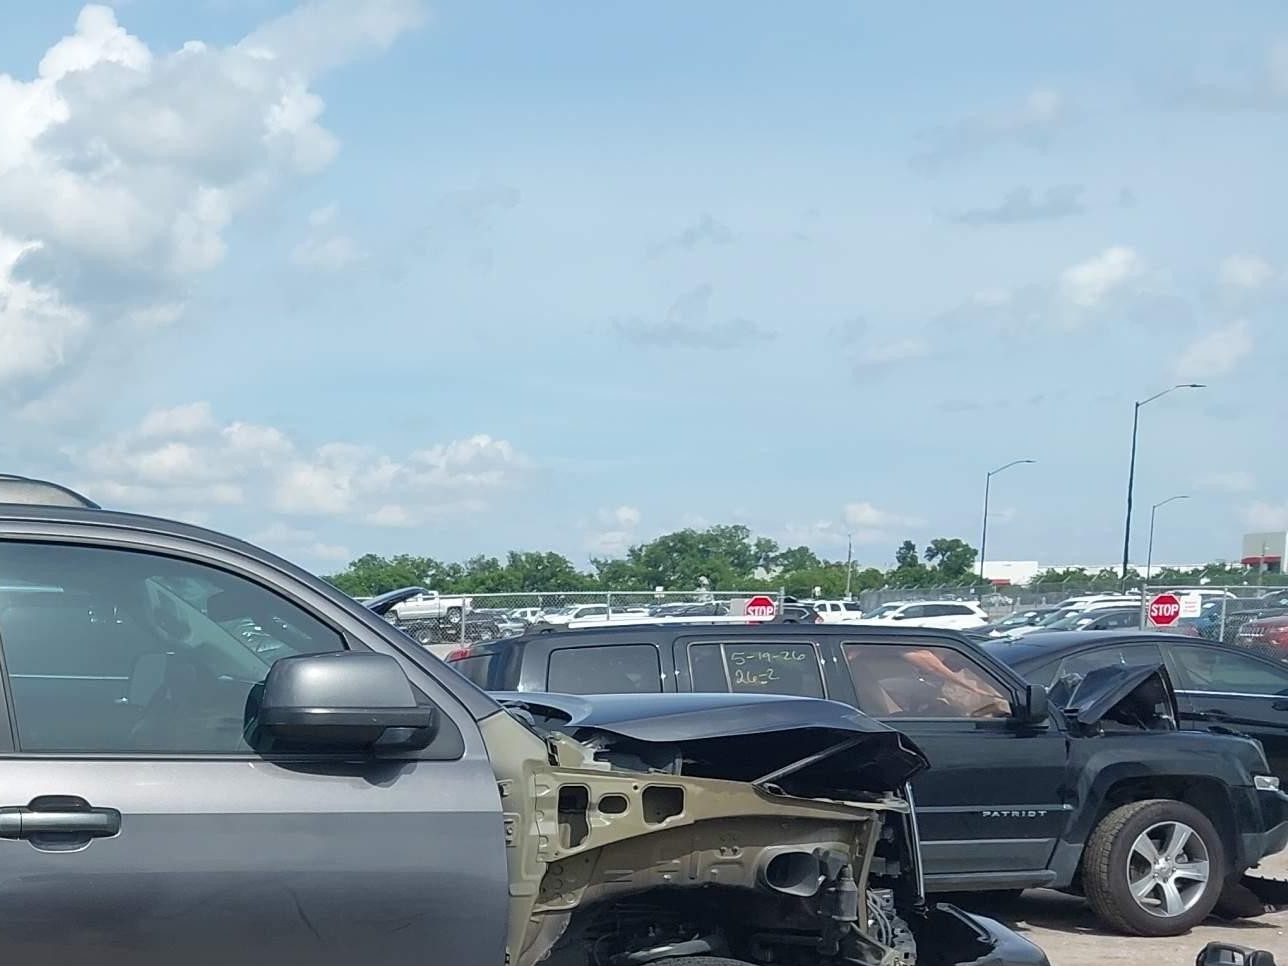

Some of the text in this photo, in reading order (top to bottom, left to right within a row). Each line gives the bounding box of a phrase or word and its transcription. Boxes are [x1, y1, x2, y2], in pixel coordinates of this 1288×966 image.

[747, 605, 774, 616] STOP
[1151, 604, 1179, 617] STOP
[730, 650, 806, 666] 5-19-26
[982, 810, 1048, 818] PATRIOT
